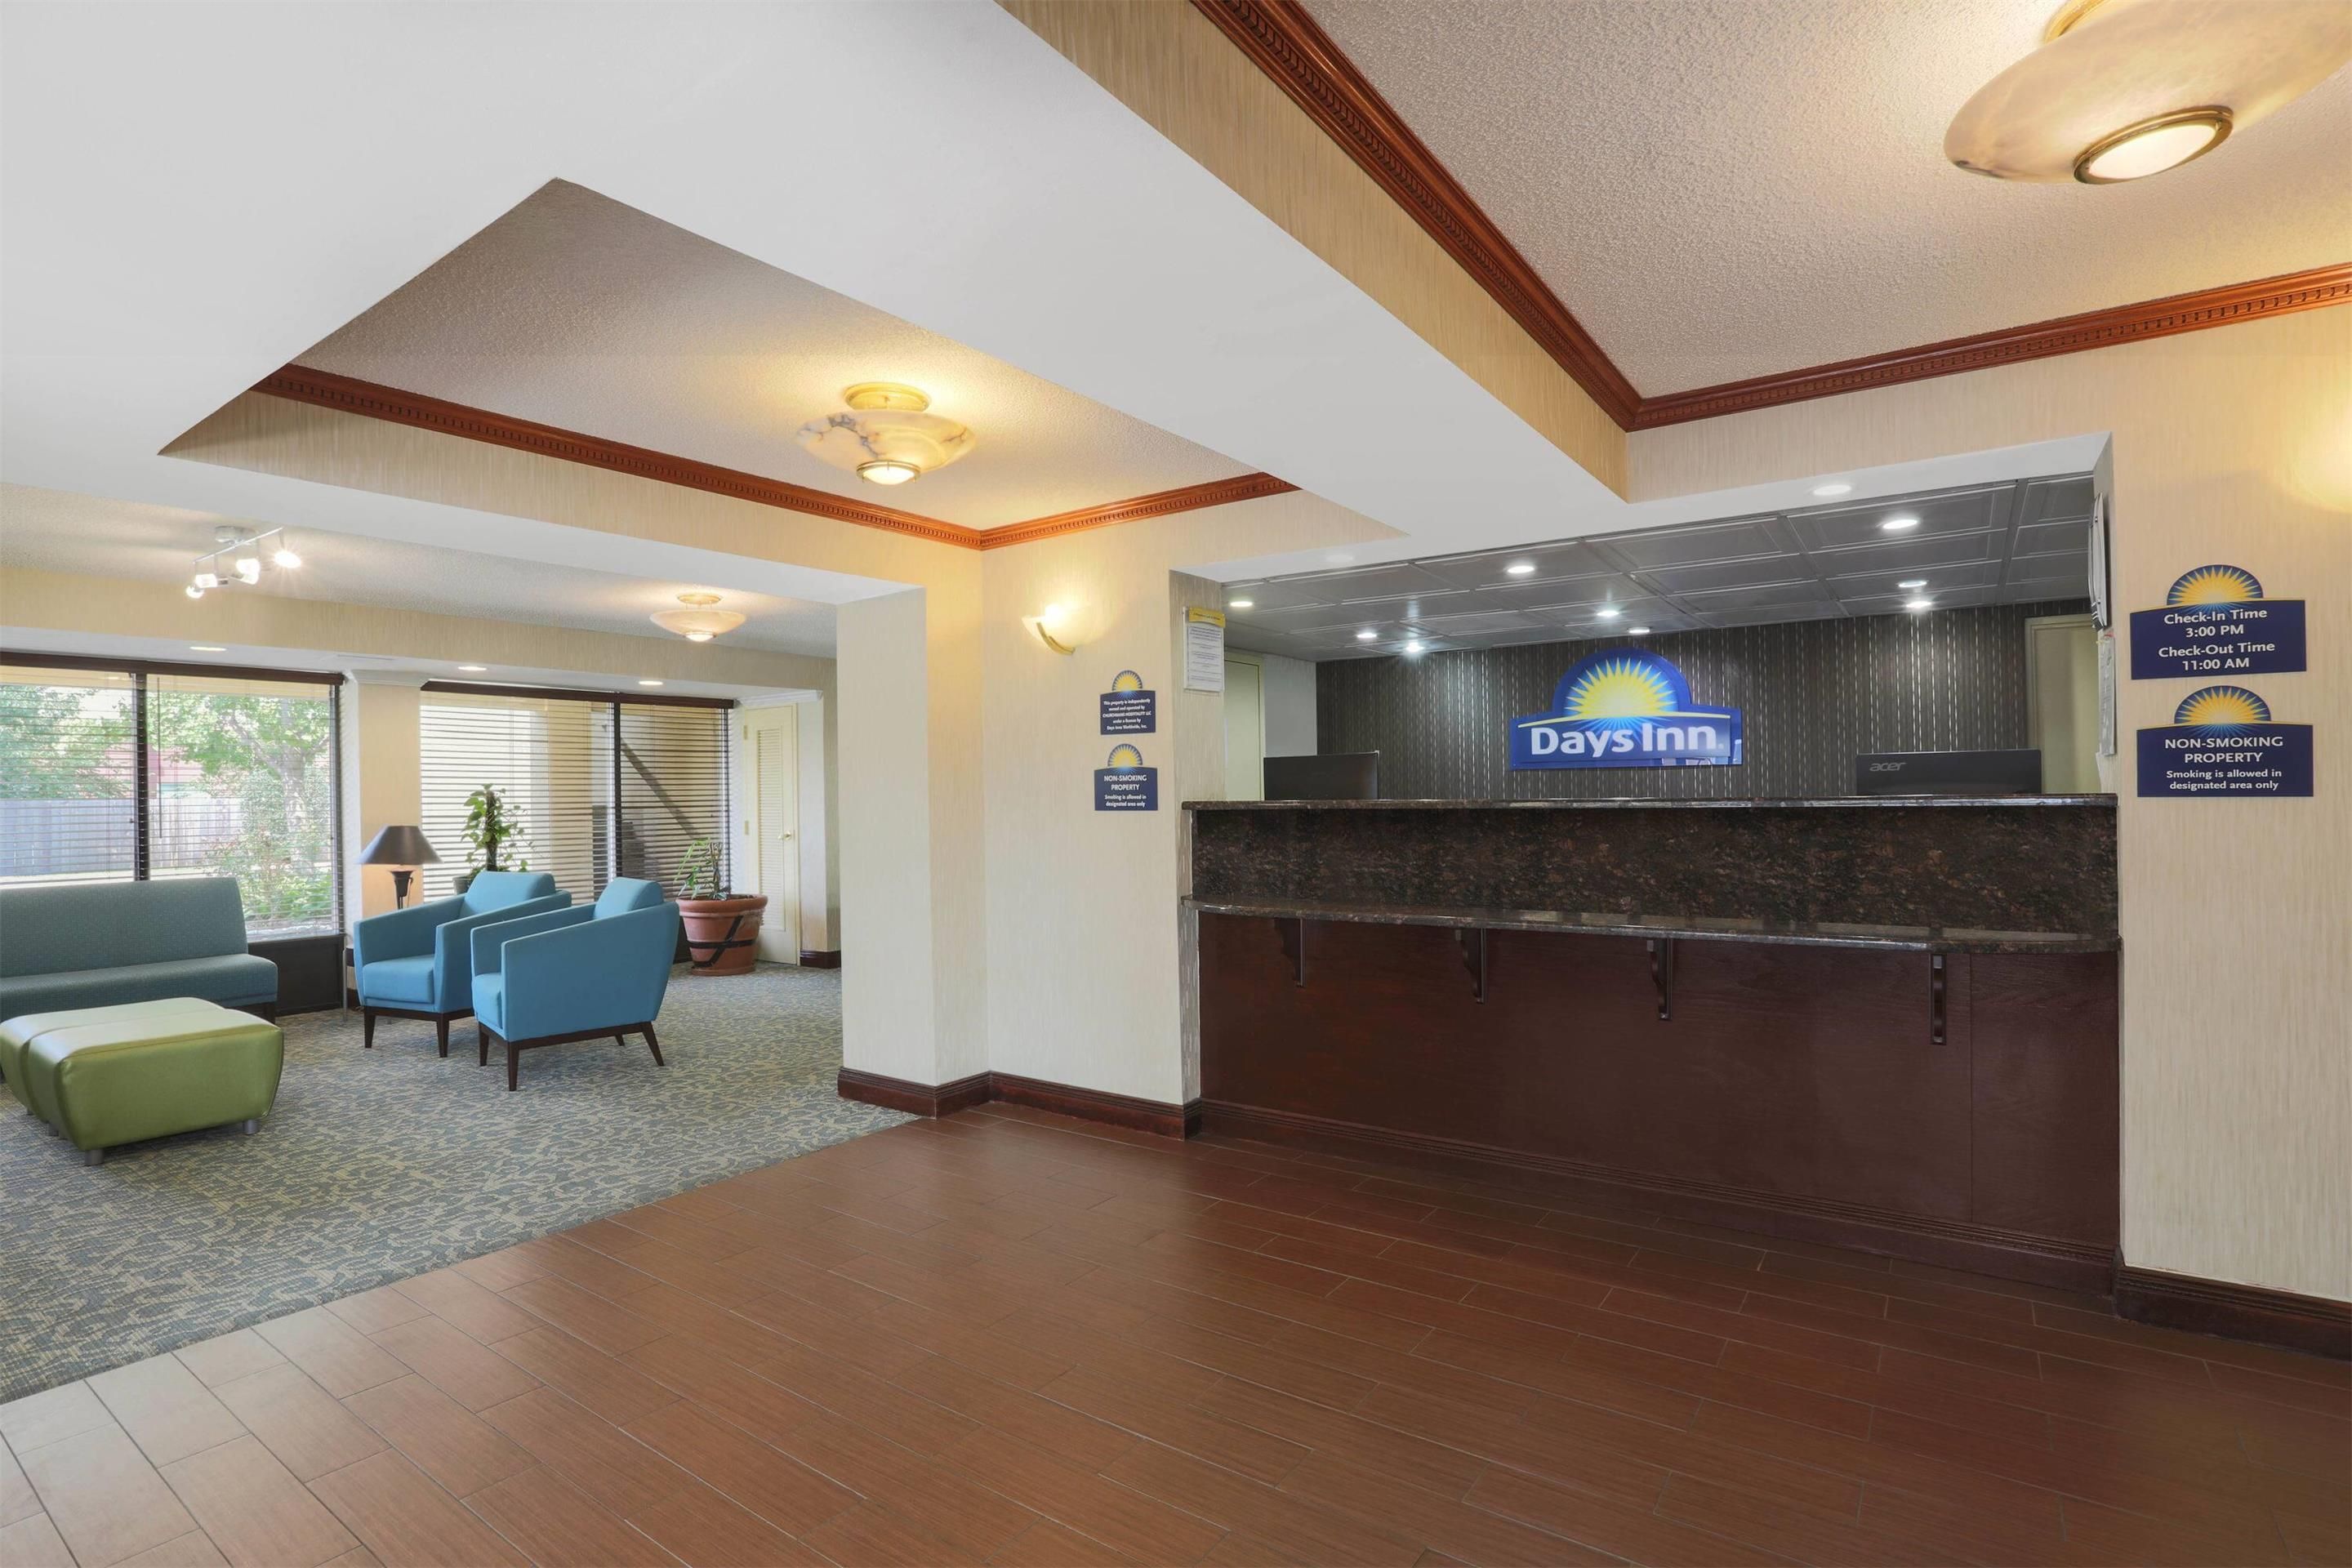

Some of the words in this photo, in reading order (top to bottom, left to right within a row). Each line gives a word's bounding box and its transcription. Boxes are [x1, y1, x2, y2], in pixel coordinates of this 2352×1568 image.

[2164, 612, 2225, 625] Check-In
[2230, 609, 2268, 619] Time
[2185, 626, 2216, 638] 3:00
[2221, 624, 2245, 635] PM
[2158, 644, 2234, 657] Check-Out
[2238, 642, 2275, 653] Time
[2182, 659, 2221, 670] 11:00
[2225, 657, 2250, 669] AM
[1530, 727, 1634, 757] Days
[1642, 723, 1717, 751] Inn
[2164, 737, 2284, 749] NON-SMOKING
[2184, 752, 2263, 764] PROPERTY
[1869, 762, 1907, 771] acer
[2166, 770, 2212, 779] Smoking
[2214, 769, 2224, 777] is
[2226, 769, 2268, 777] allowed
[2271, 768, 2282, 777] in
[2169, 781, 2226, 791] designated
[2255, 780, 2278, 791] only
